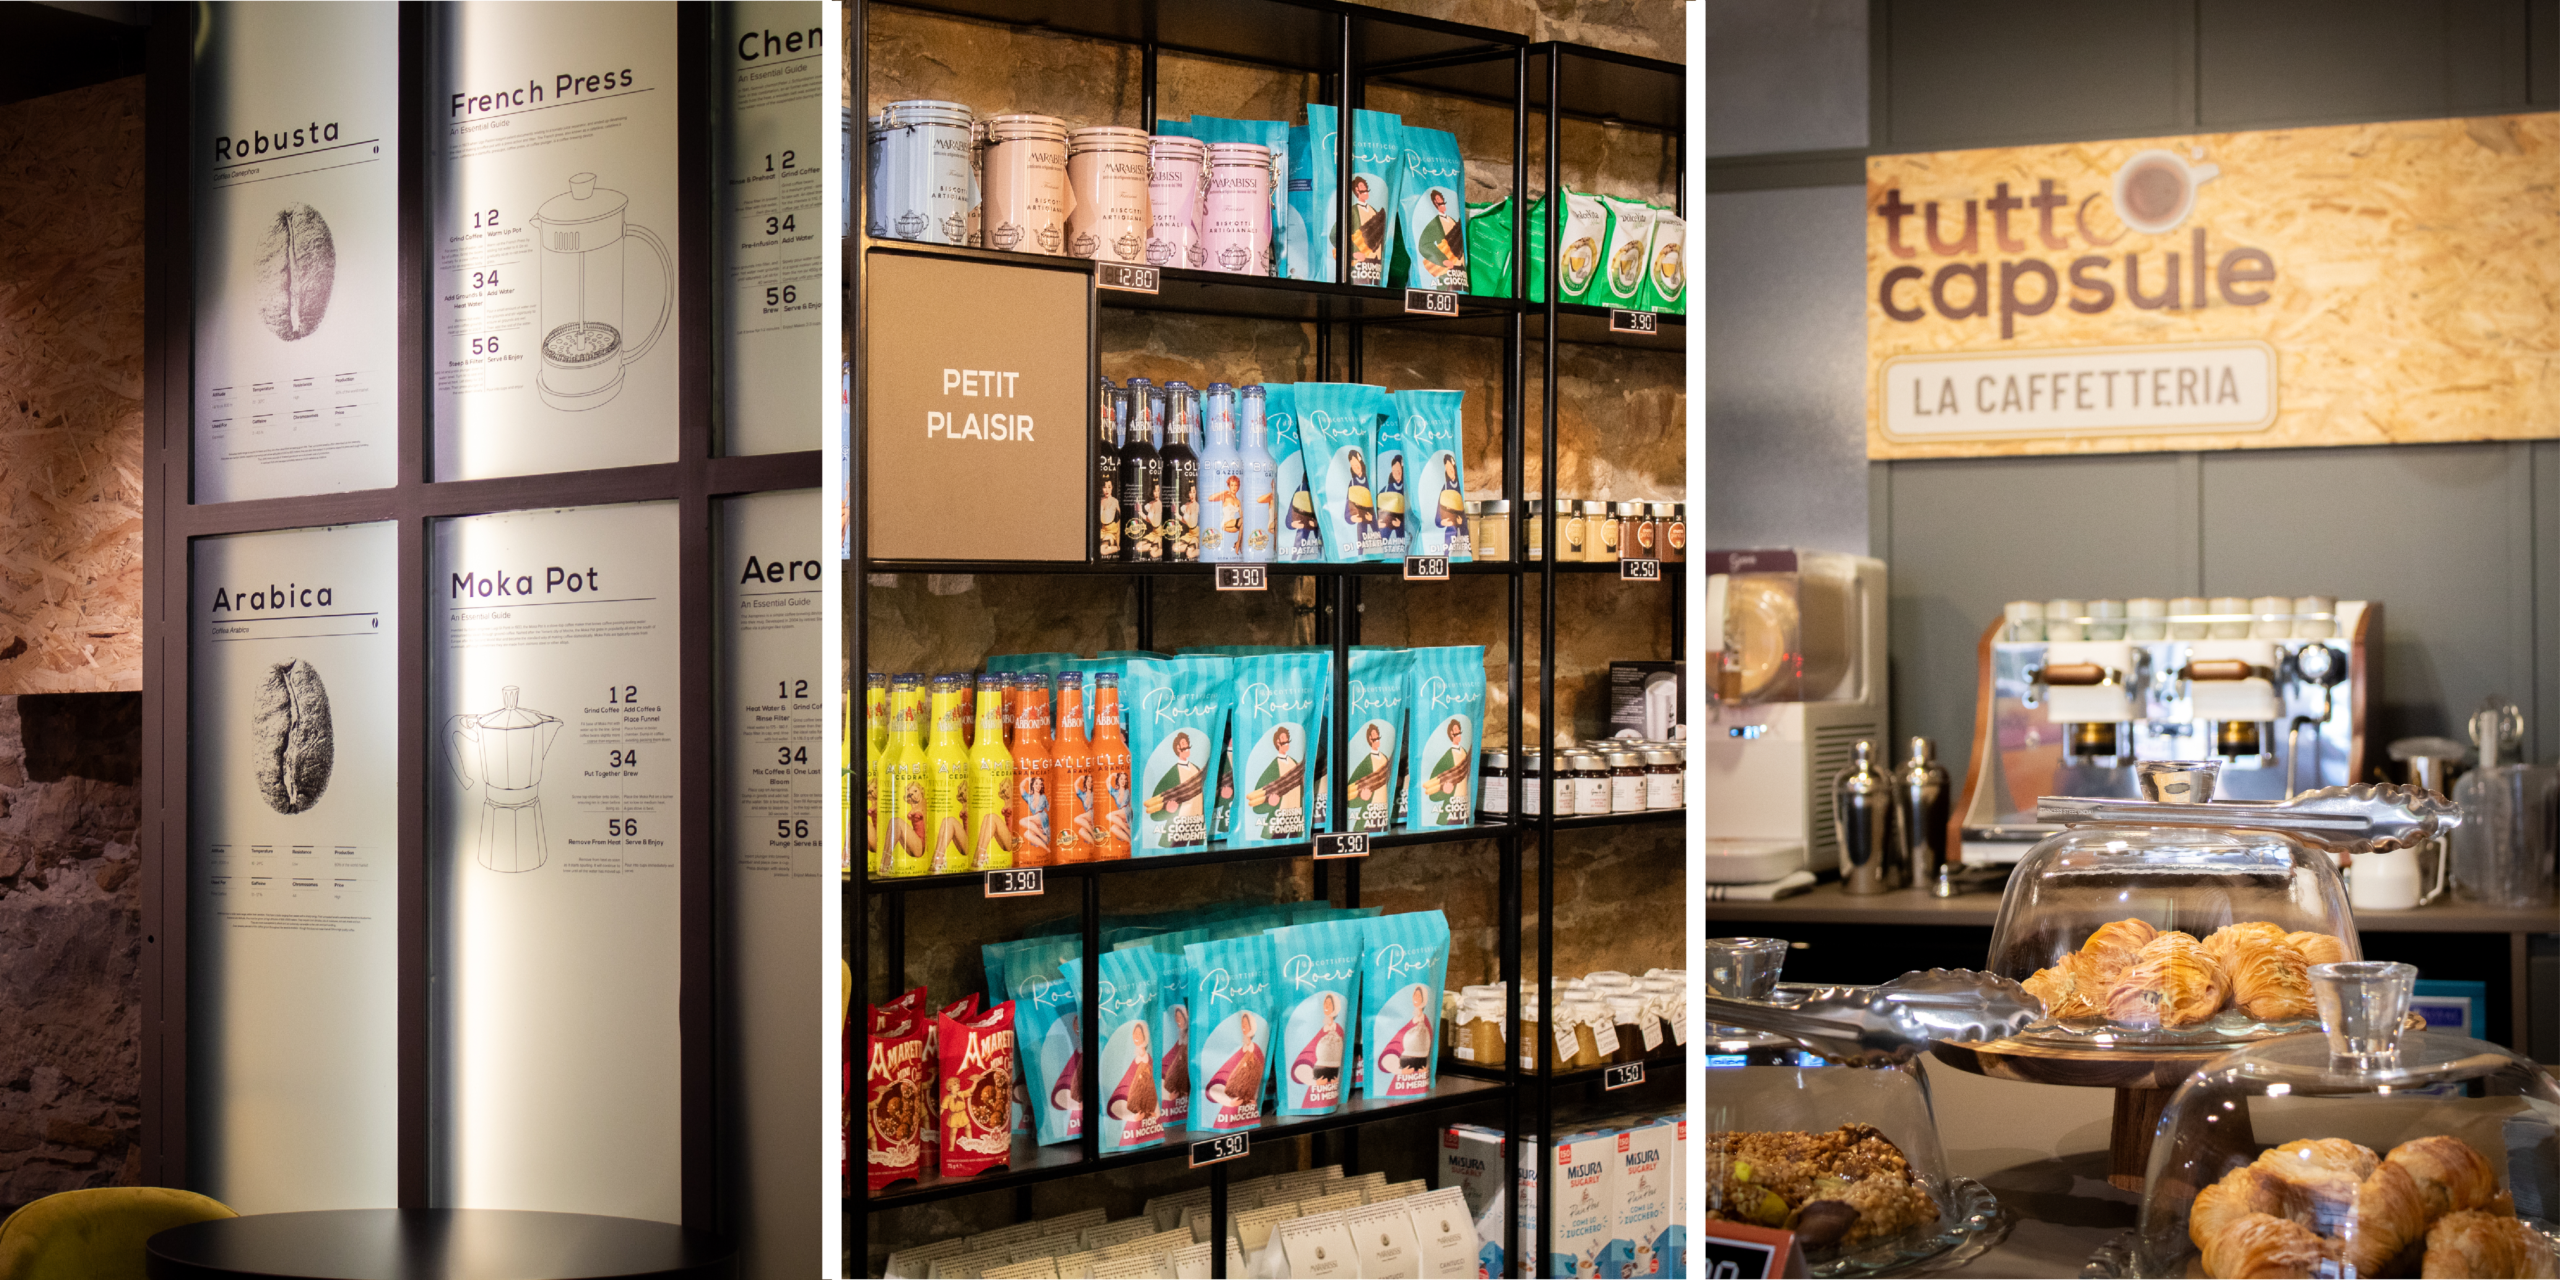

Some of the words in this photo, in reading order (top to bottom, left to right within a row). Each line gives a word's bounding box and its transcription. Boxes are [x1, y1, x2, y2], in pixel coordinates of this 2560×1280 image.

[750, 68, 783, 81] Essential
[784, 64, 808, 74] Guide
[451, 79, 544, 117] French
[556, 68, 633, 99] Press
[450, 127, 459, 136] An
[460, 121, 490, 134] Essential
[491, 118, 510, 129] Guide
[214, 119, 341, 162] Robusta
[781, 170, 798, 179] Grind
[799, 167, 820, 176] Coffee
[781, 237, 794, 245] Add
[794, 234, 815, 243] Water
[1878, 227, 2277, 340] capsule
[762, 306, 779, 314] Brew
[943, 368, 1020, 398] PETIT
[1913, 376, 1959, 416] LA
[1976, 365, 2241, 414] CAFFETTERIA
[927, 411, 1035, 441] PLAISIR
[740, 555, 822, 585] Aero
[452, 569, 533, 599] Moka
[546, 566, 599, 594] Pot
[211, 583, 333, 613] Arabica
[740, 600, 752, 609] An
[753, 598, 787, 608] Essential
[788, 597, 811, 606] Guide
[450, 613, 460, 621] An
[461, 612, 490, 621] Essential
[491, 611, 511, 620] Guide
[230, 626, 250, 634] Arabica
[1420, 675, 1481, 711] Roero
[1142, 686, 1218, 725] Roero
[1241, 682, 1313, 719] Roero
[773, 714, 790, 722] Filter
[595, 770, 621, 778] Together
[1255, 818, 1268, 826] AL
[1153, 825, 1167, 834] AL
[607, 838, 621, 846] Heat
[625, 838, 641, 846] Serve
[647, 838, 664, 847] Enjoy
[769, 840, 791, 848] Plunge
[1283, 954, 1355, 991] Roero
[1200, 967, 1270, 1005] Roero
[1395, 1081, 1406, 1090] DI
[1237, 1104, 1256, 1114] FIOR
[1141, 1117, 1157, 1127] FIOR
[1217, 1113, 1229, 1123] DI
[1123, 1129, 1135, 1139] DI
[1628, 1162, 1657, 1175] SUGARLY
[1570, 1175, 1600, 1188] SUGARLY
[1630, 1204, 1645, 1213] COME
[1645, 1202, 1654, 1211] LO
[1572, 1219, 1587, 1228] COME
[1588, 1215, 1597, 1225] LO
[1624, 1210, 1660, 1225] ZUCCHERO
[1566, 1223, 1603, 1239] ZUCCHERO
